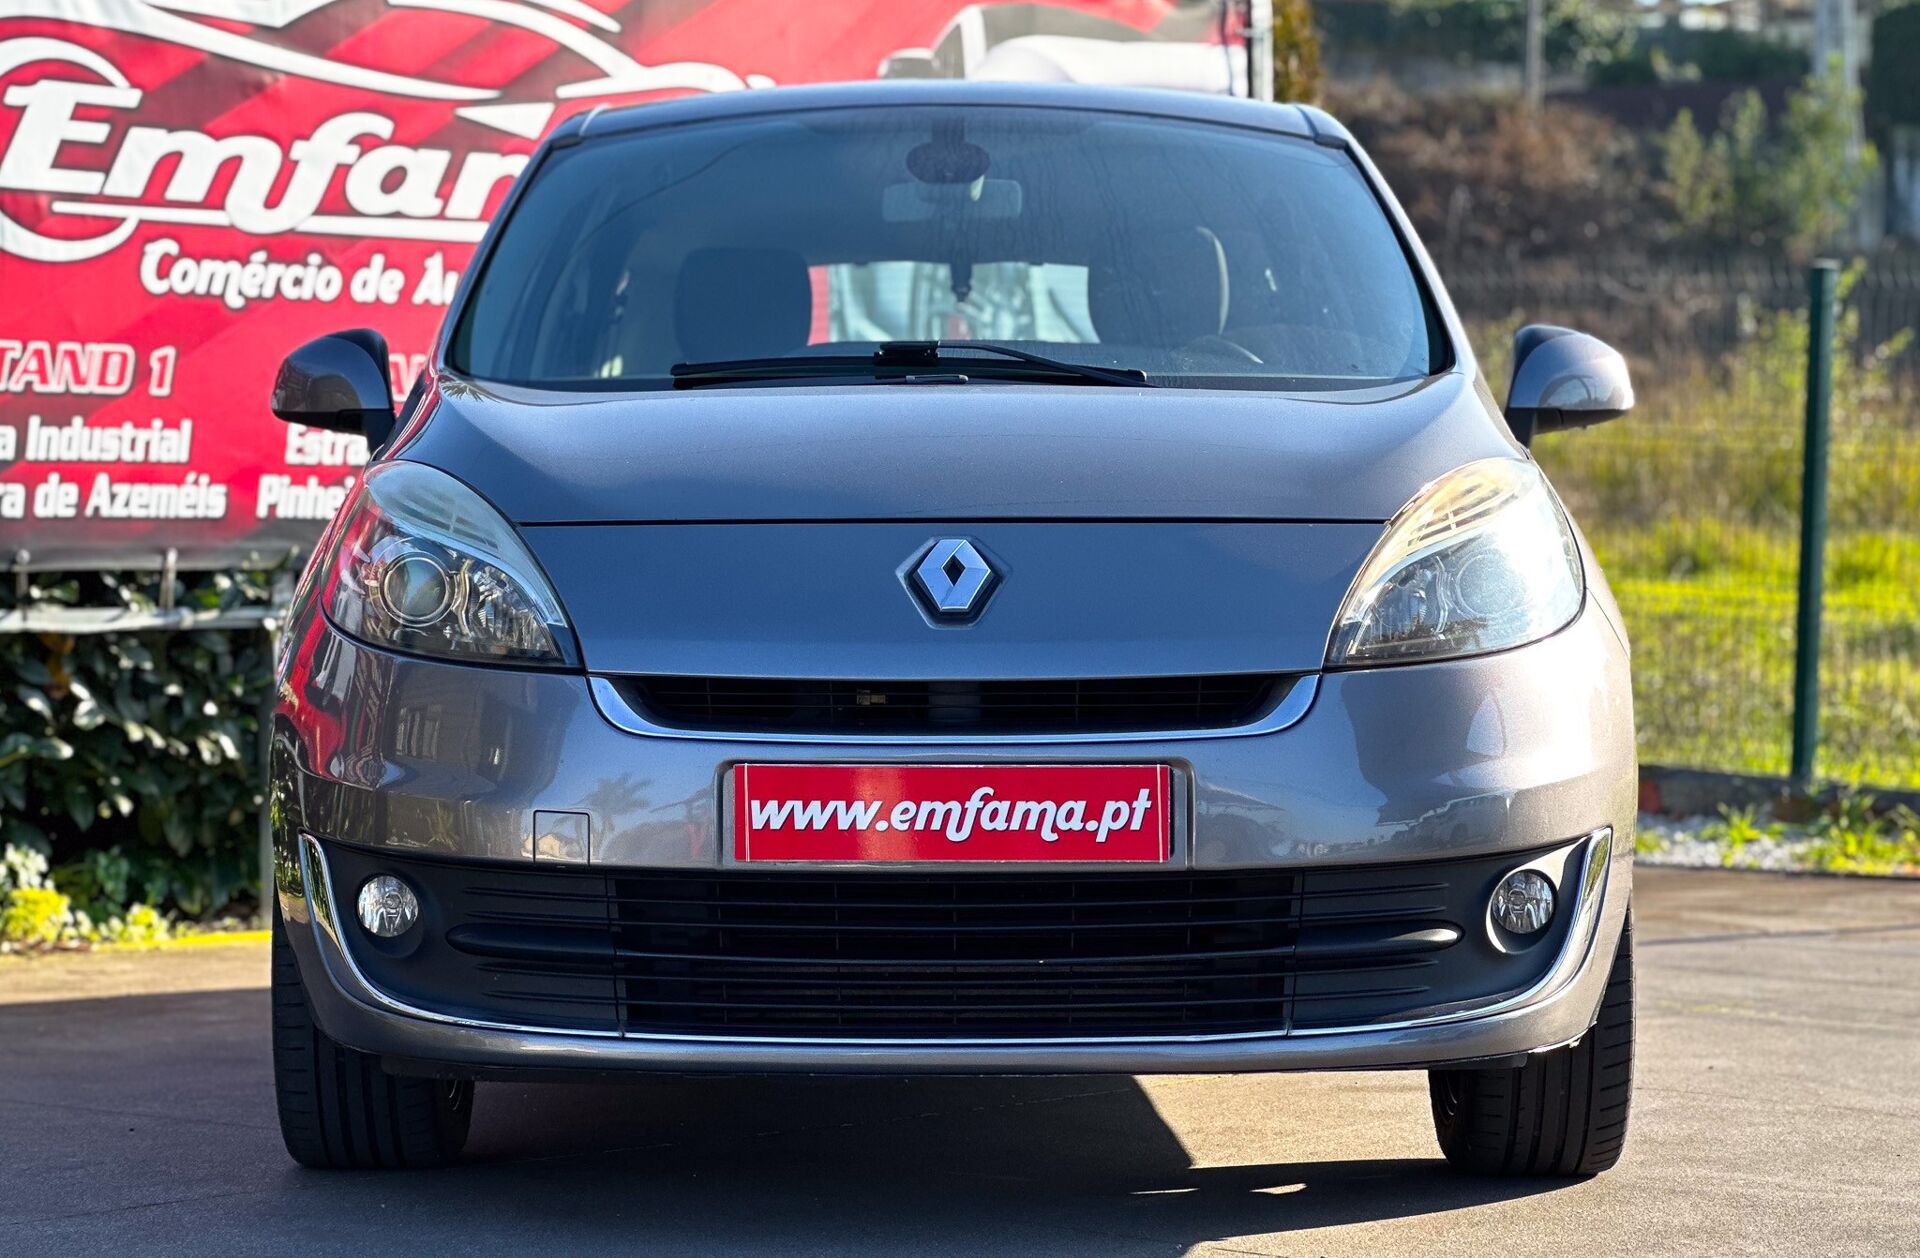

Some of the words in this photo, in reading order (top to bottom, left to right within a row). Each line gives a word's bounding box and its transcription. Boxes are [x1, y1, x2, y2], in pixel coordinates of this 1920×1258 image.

[140, 238, 343, 309] Comércio
[350, 253, 404, 305] de
[148, 346, 176, 397] 1
[25, 415, 193, 463] Industrial
[33, 472, 79, 518] de
[84, 471, 228, 519] Azeméis
[750, 786, 1152, 842] www.emfama.pt
